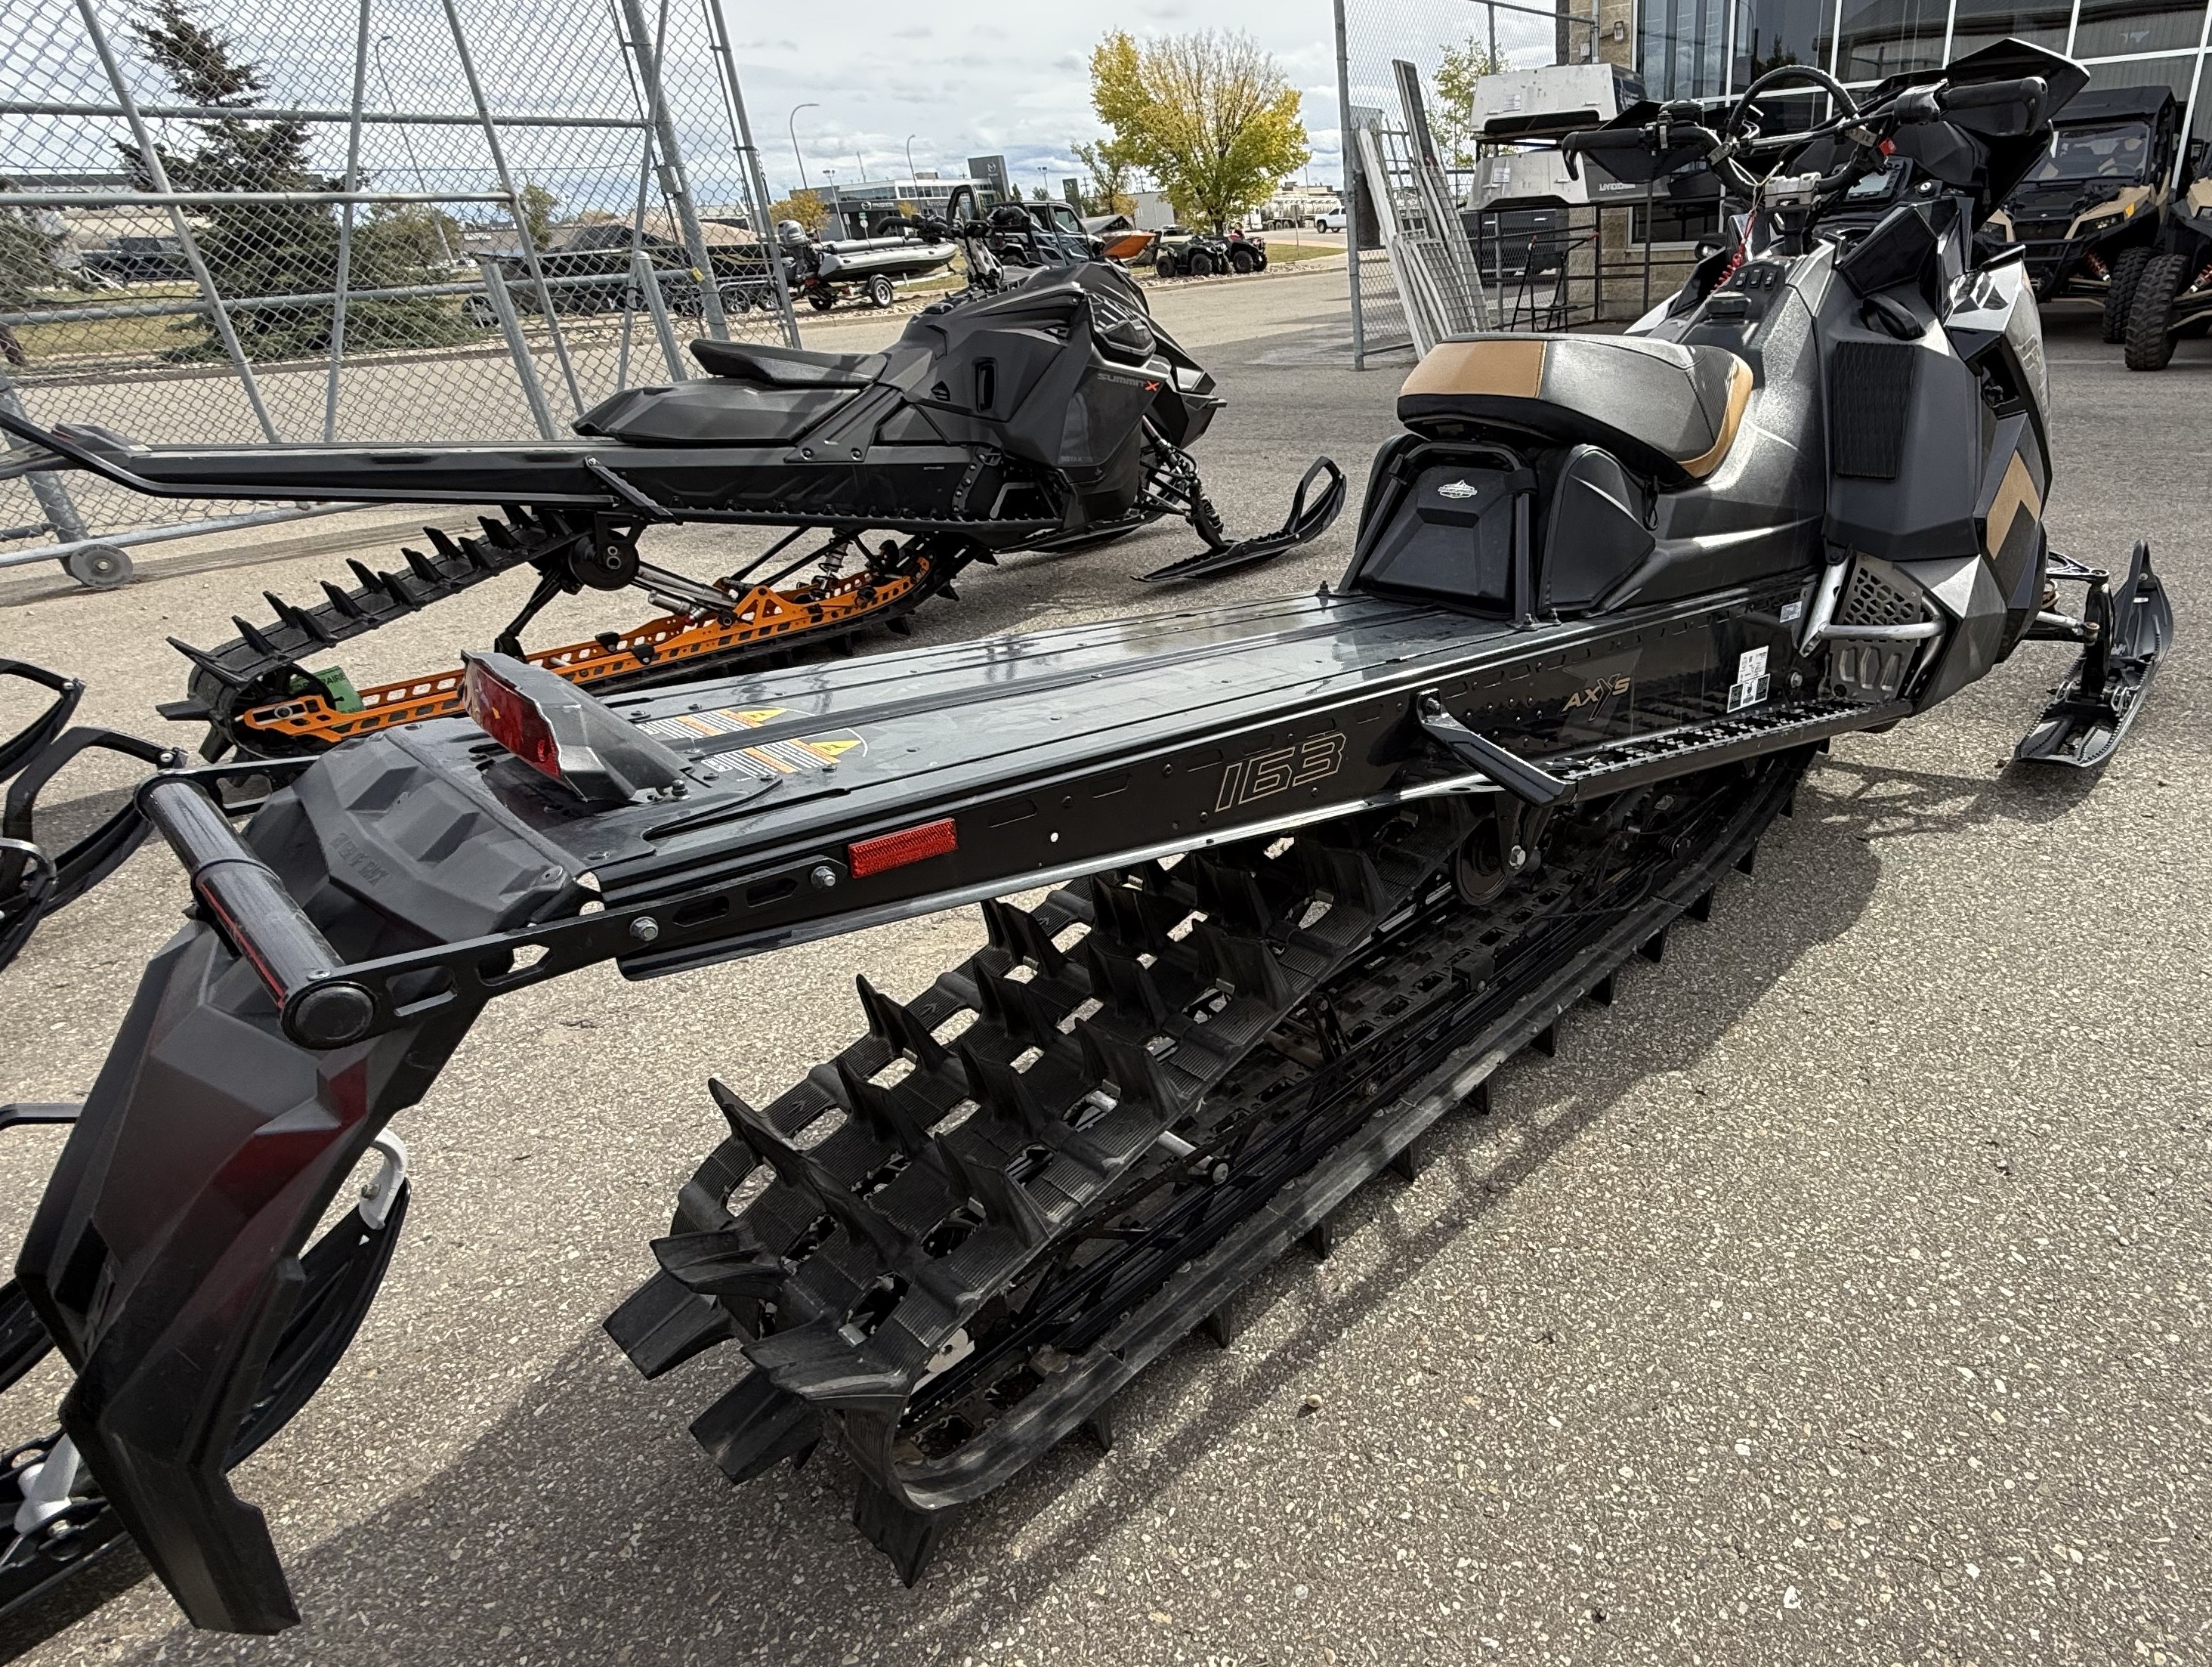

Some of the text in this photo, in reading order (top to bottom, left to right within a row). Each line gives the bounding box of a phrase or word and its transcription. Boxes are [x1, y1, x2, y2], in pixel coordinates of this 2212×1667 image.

[1145, 379, 1160, 391] X
[1562, 673, 1631, 722] AXYS
[1215, 732, 1347, 812] 163
